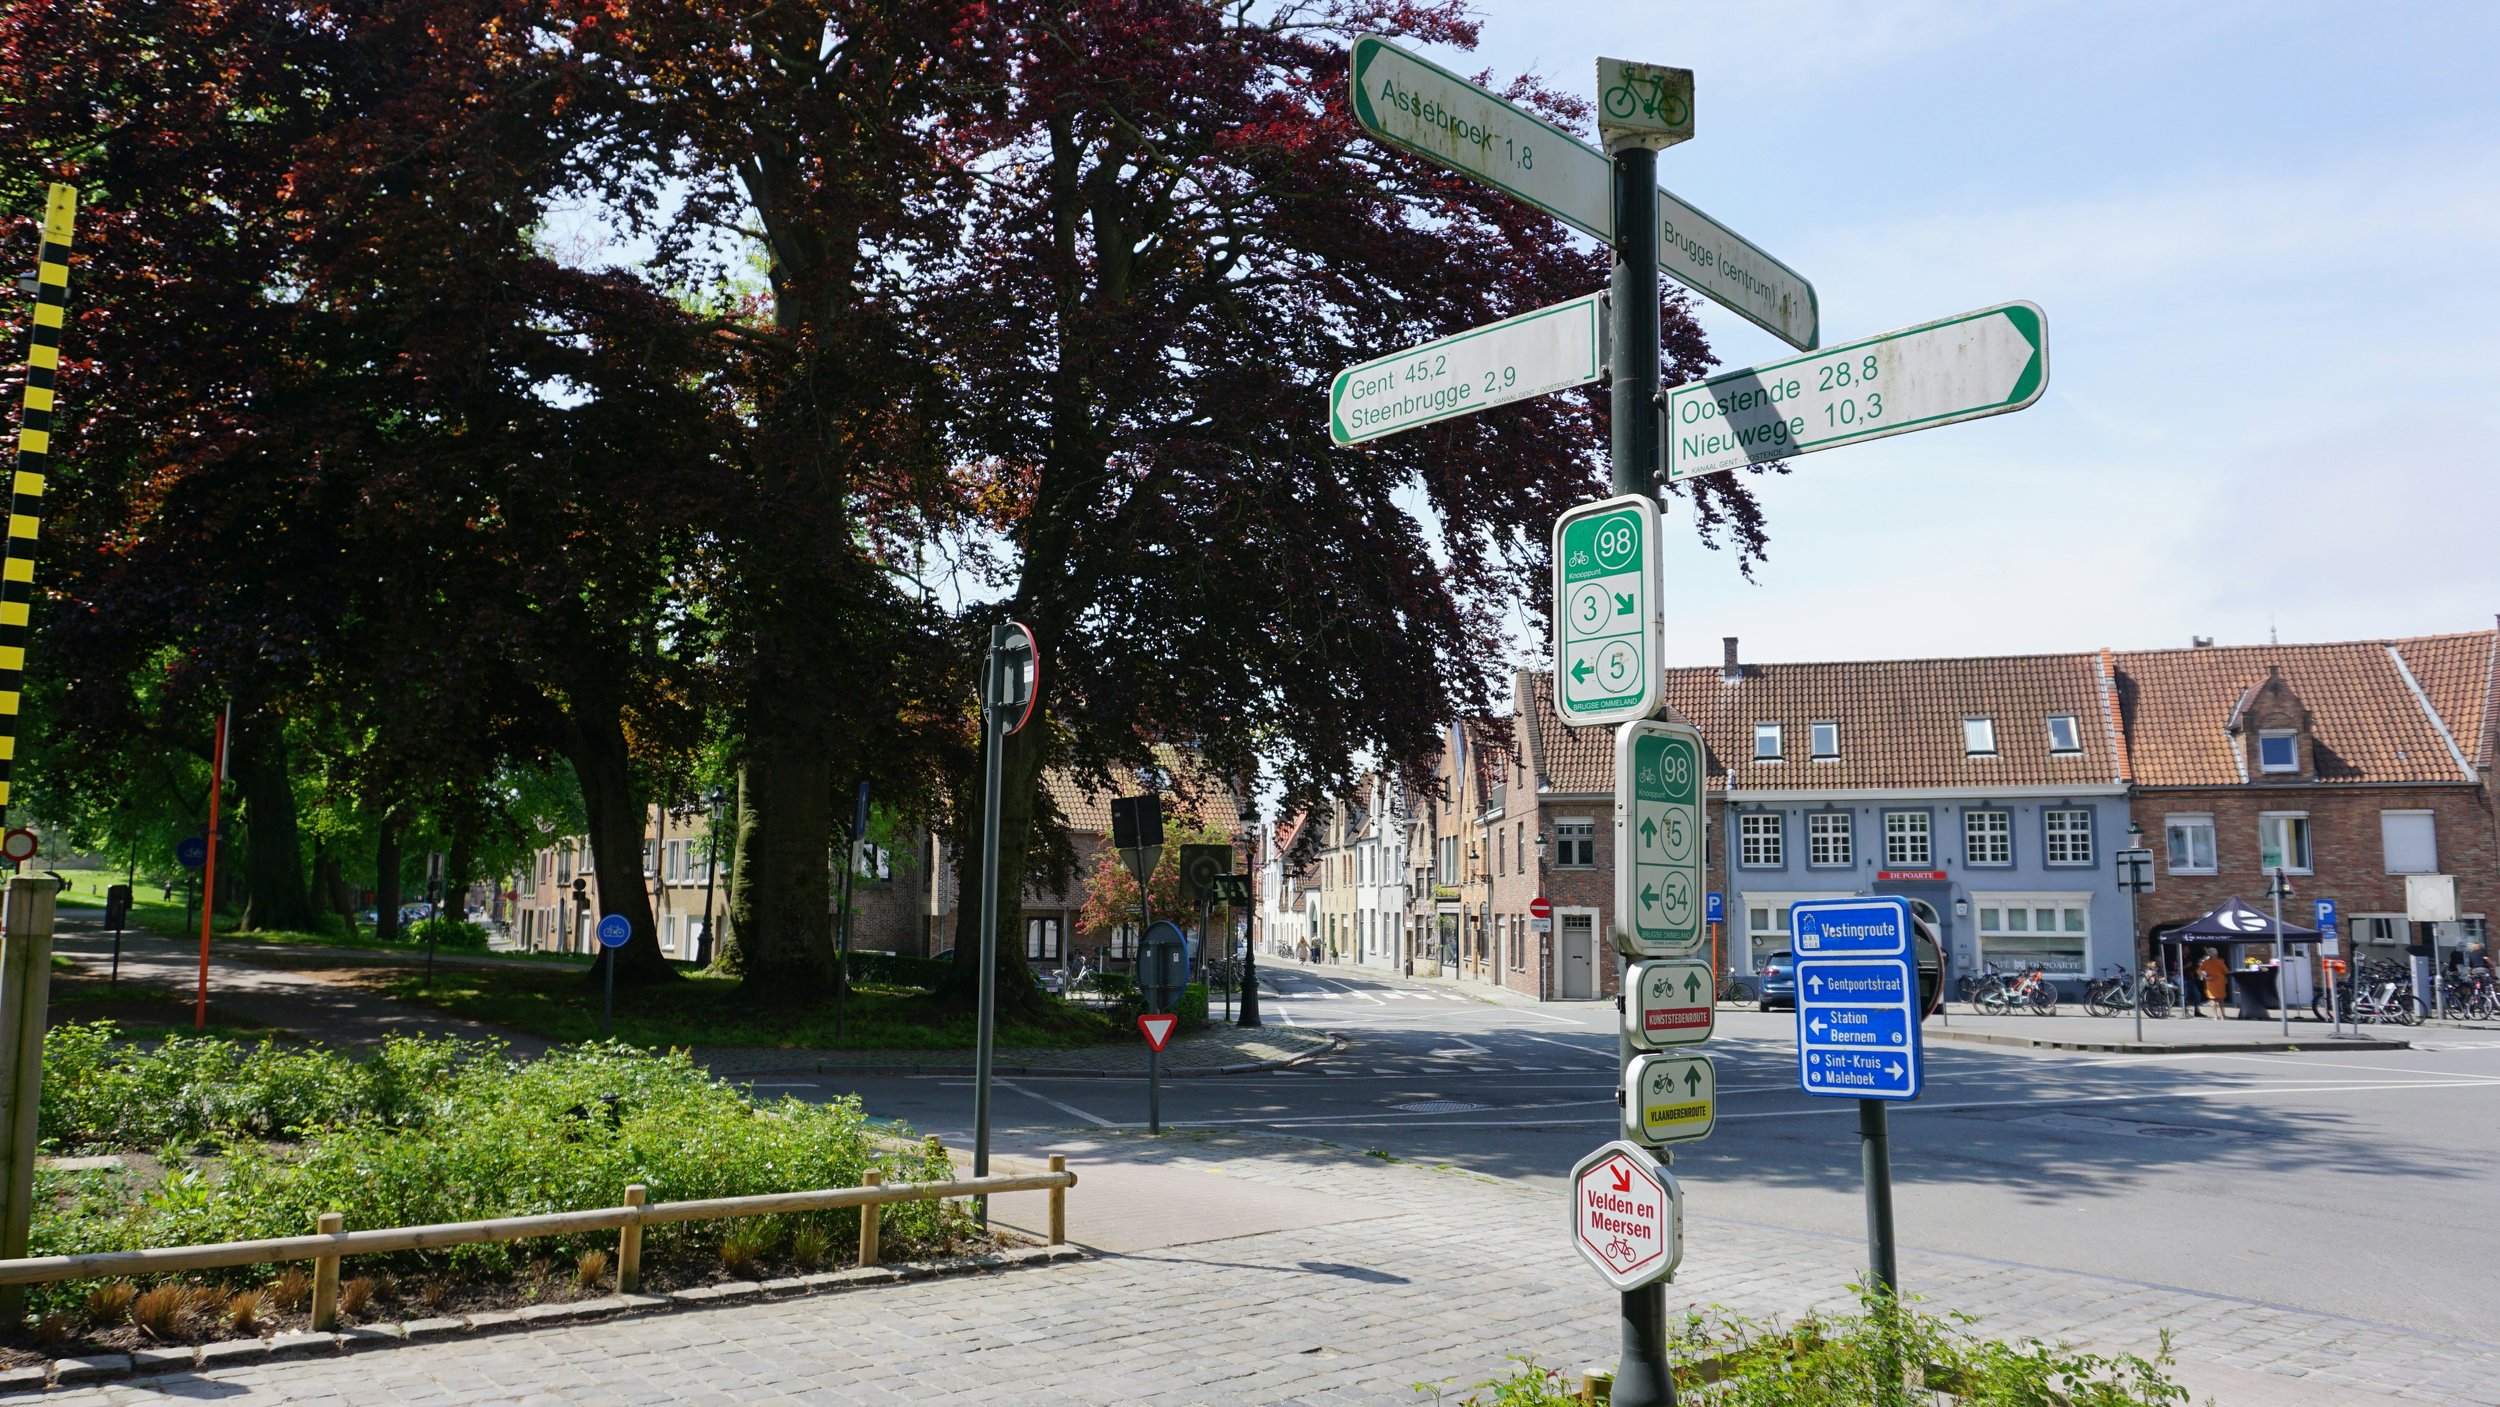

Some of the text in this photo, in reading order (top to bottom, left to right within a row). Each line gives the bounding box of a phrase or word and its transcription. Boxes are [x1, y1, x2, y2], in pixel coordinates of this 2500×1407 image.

[1381, 79, 1533, 170] Assebroek 1,8
[1664, 220, 1713, 267] Brugge
[1718, 253, 1776, 308] (centrum)
[1352, 371, 1394, 400] Gent
[1405, 355, 1446, 383] 45,2
[1681, 355, 1878, 424] Oostende 28,8
[1351, 366, 1516, 429] Steenbrugge 2,9
[1494, 393, 1518, 404] KANAAL
[1518, 389, 1536, 400] GENT
[1540, 379, 1575, 393] OOSTENDE
[1682, 393, 1883, 460] Nieuwege 10,3
[1691, 462, 1718, 474] KANAAL
[1719, 457, 1738, 468] GENT
[1743, 448, 1784, 462] OOSTENDE
[1600, 528, 1631, 557] 98
[1568, 568, 1601, 580] Knooppunt
[1583, 595, 1597, 621] 3
[1610, 651, 1625, 679] 5
[1573, 697, 1638, 711] BRUGSE OMMELAND
[1664, 756, 1688, 784] 98
[1638, 789, 1666, 799] Knooppunt
[1665, 884, 1688, 911] 54
[1708, 896, 1721, 913] P
[2318, 903, 2333, 921] P
[1641, 930, 1691, 939] BRUGSE OMMELAND
[1821, 922, 1895, 941] Vestingroute
[1828, 977, 1900, 994] Gentpoortstraat
[1649, 1012, 1707, 1026] KUNSTSTEDENROUTE
[1830, 1010, 1868, 1025] Station
[1830, 1028, 1877, 1043] Beernem
[1825, 1053, 1881, 1069] Sint-Kruis
[1826, 1070, 1875, 1086] Malehoek
[1650, 1105, 1706, 1122] VLAANDERENROUTE
[1588, 1189, 1654, 1219] Velden en
[1591, 1211, 1651, 1240] Meersen
